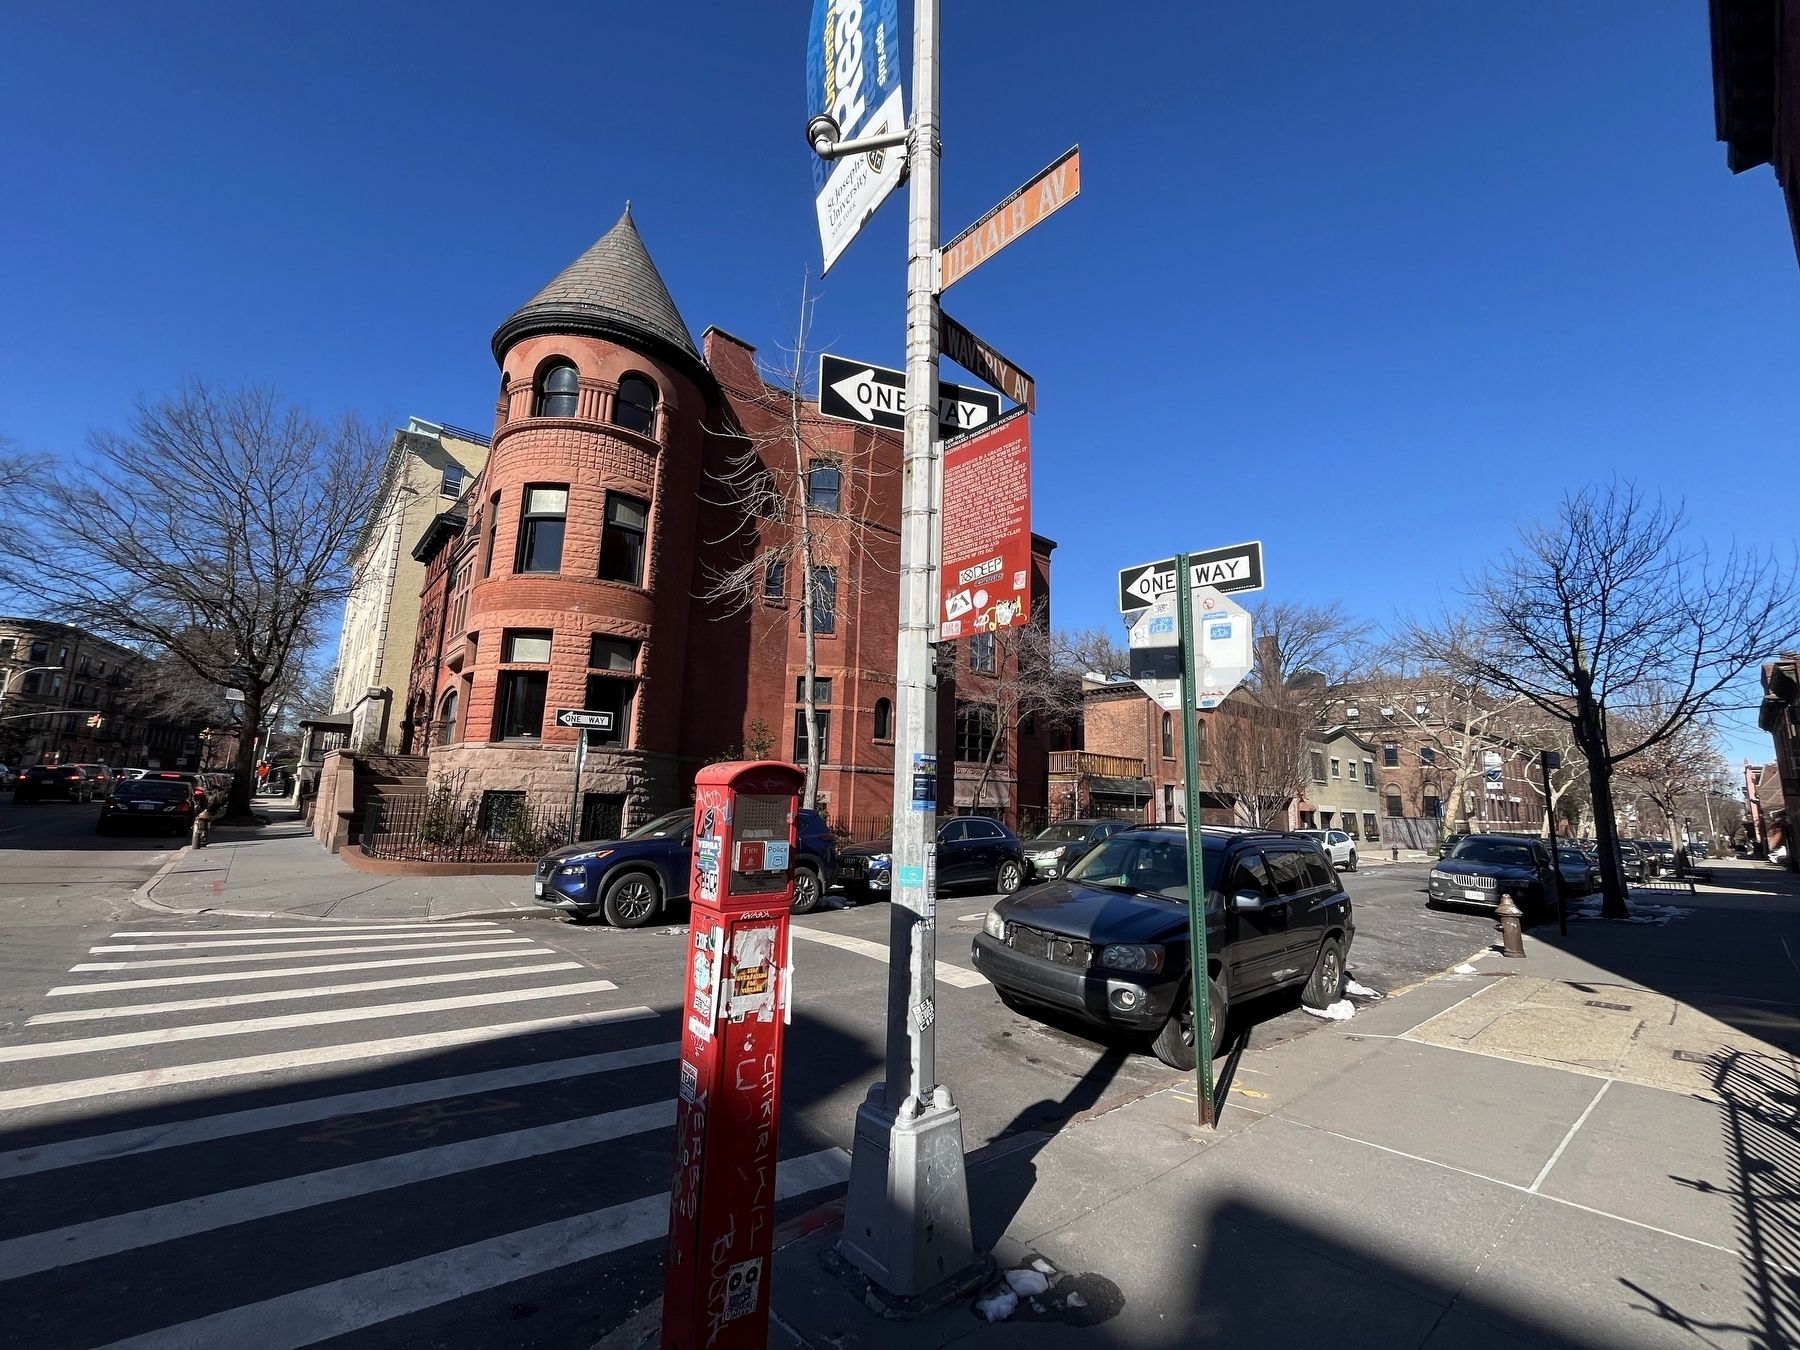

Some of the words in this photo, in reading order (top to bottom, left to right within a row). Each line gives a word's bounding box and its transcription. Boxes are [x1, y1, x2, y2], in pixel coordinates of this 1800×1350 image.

[823, 7, 836, 114] University
[832, 0, 866, 144] Rea
[876, 22, 887, 87] sjny.edu
[948, 198, 1025, 281] DEKALB
[1038, 162, 1067, 215] AV
[947, 323, 1008, 391] WAVERLY
[1013, 373, 1029, 404] AV
[857, 382, 906, 412] ONE
[1139, 573, 1176, 595] ONE
[1195, 560, 1240, 584] WAY
[565, 715, 582, 723] ONE
[588, 716, 606, 724] WAY
[768, 845, 789, 853] Police
